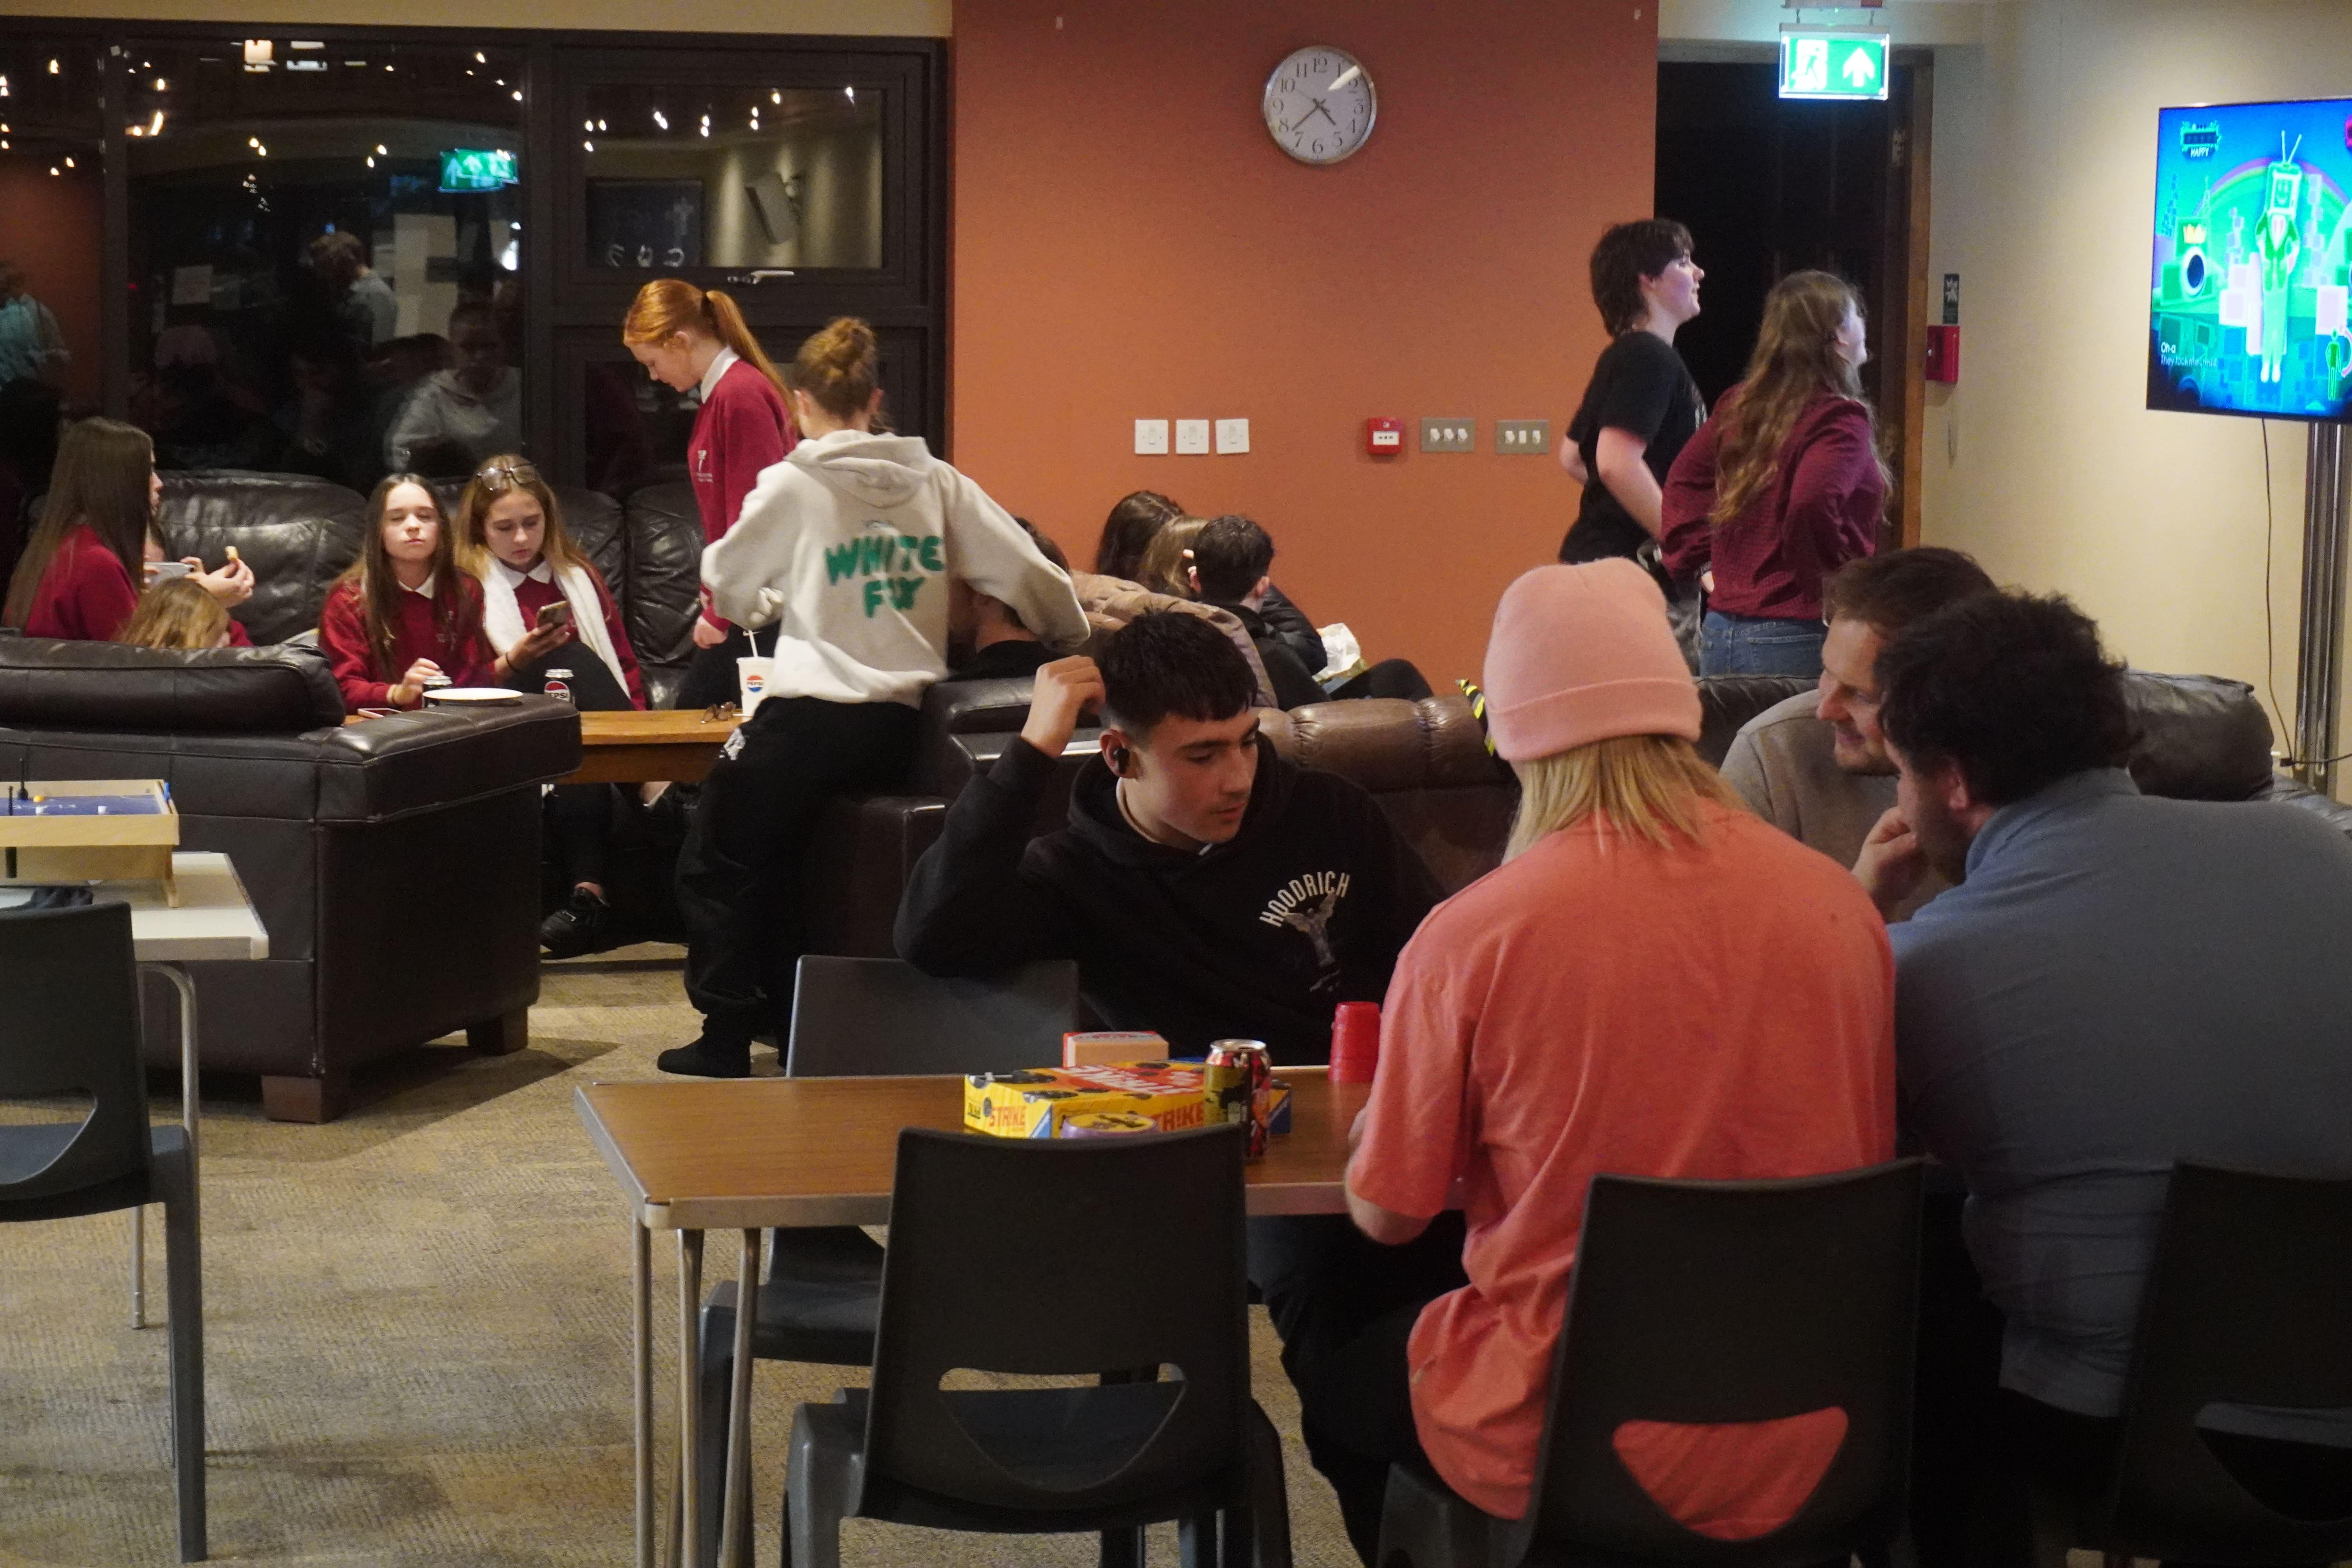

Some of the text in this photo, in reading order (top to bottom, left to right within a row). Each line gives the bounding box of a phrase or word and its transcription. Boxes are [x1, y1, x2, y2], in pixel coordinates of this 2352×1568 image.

[1296, 62, 1307, 77] 11
[1313, 57, 1328, 73] 12
[1337, 63, 1341, 77] 1
[1281, 78, 1296, 93] 10
[1348, 78, 1358, 94] 2
[1273, 98, 1284, 114] 9
[1354, 98, 1364, 114] 3
[1278, 118, 1289, 132] 8
[1346, 118, 1356, 133] 4
[1294, 131, 1304, 148] 7
[1312, 137, 1323, 154] 6
[1333, 131, 1343, 147] 5
[2190, 147, 2209, 158] HAPPY
[824, 535, 945, 586] WHITE
[1259, 870, 1351, 928] HOODRICH
